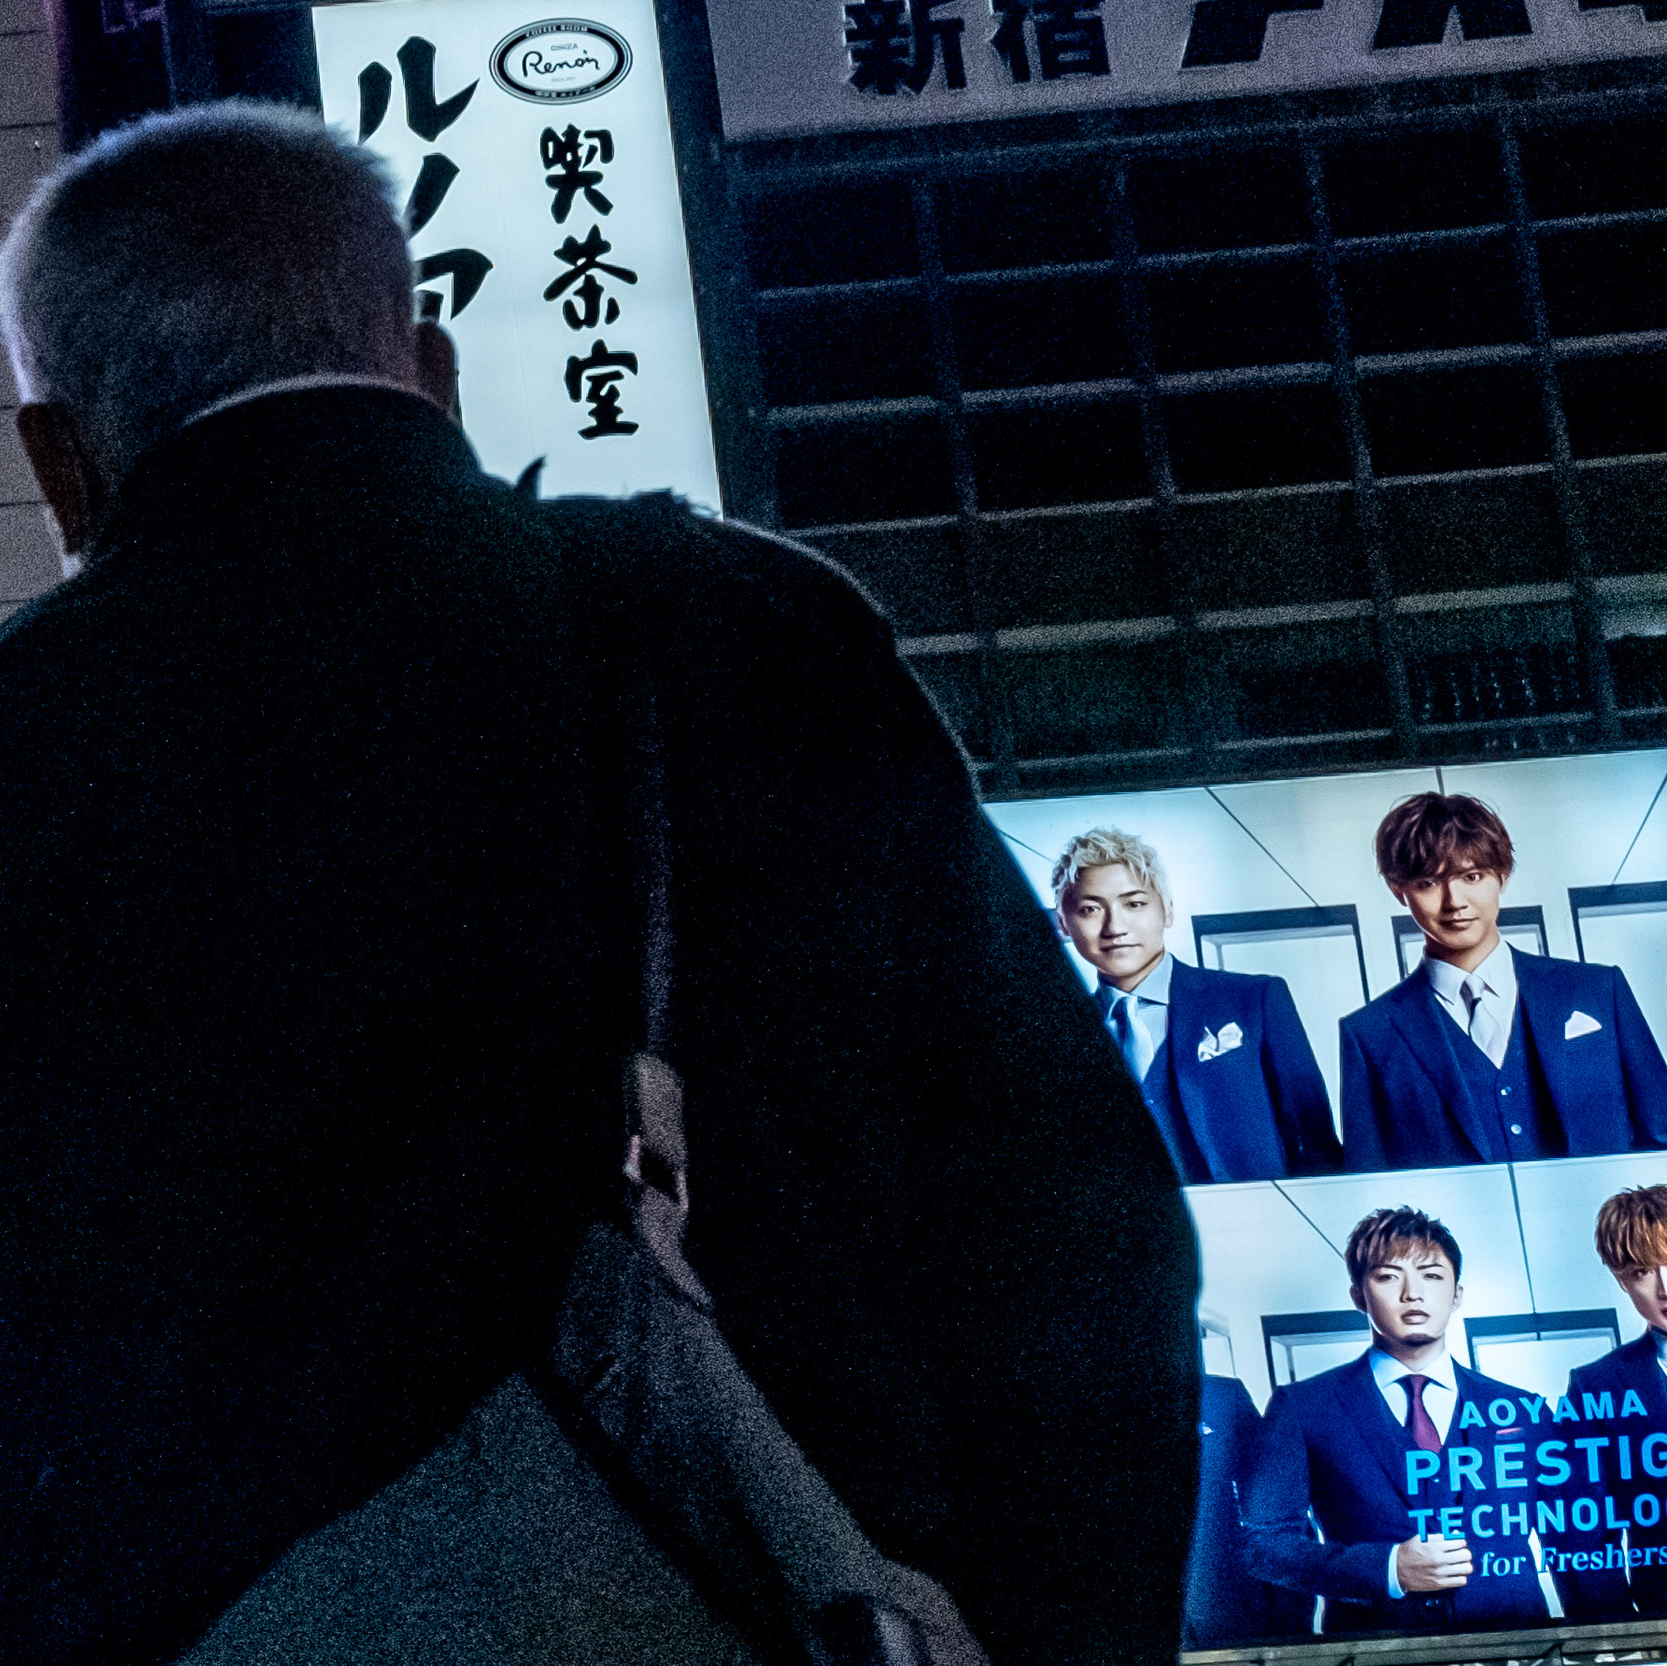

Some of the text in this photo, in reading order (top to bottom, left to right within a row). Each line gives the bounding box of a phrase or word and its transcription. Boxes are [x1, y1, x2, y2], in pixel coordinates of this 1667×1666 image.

[539, 126, 639, 440] 喫茶室
[1459, 1389, 1648, 1429] AOYAMA
[1407, 1492, 1667, 1543] TECHNOLO
[1480, 1552, 1527, 1577] for
